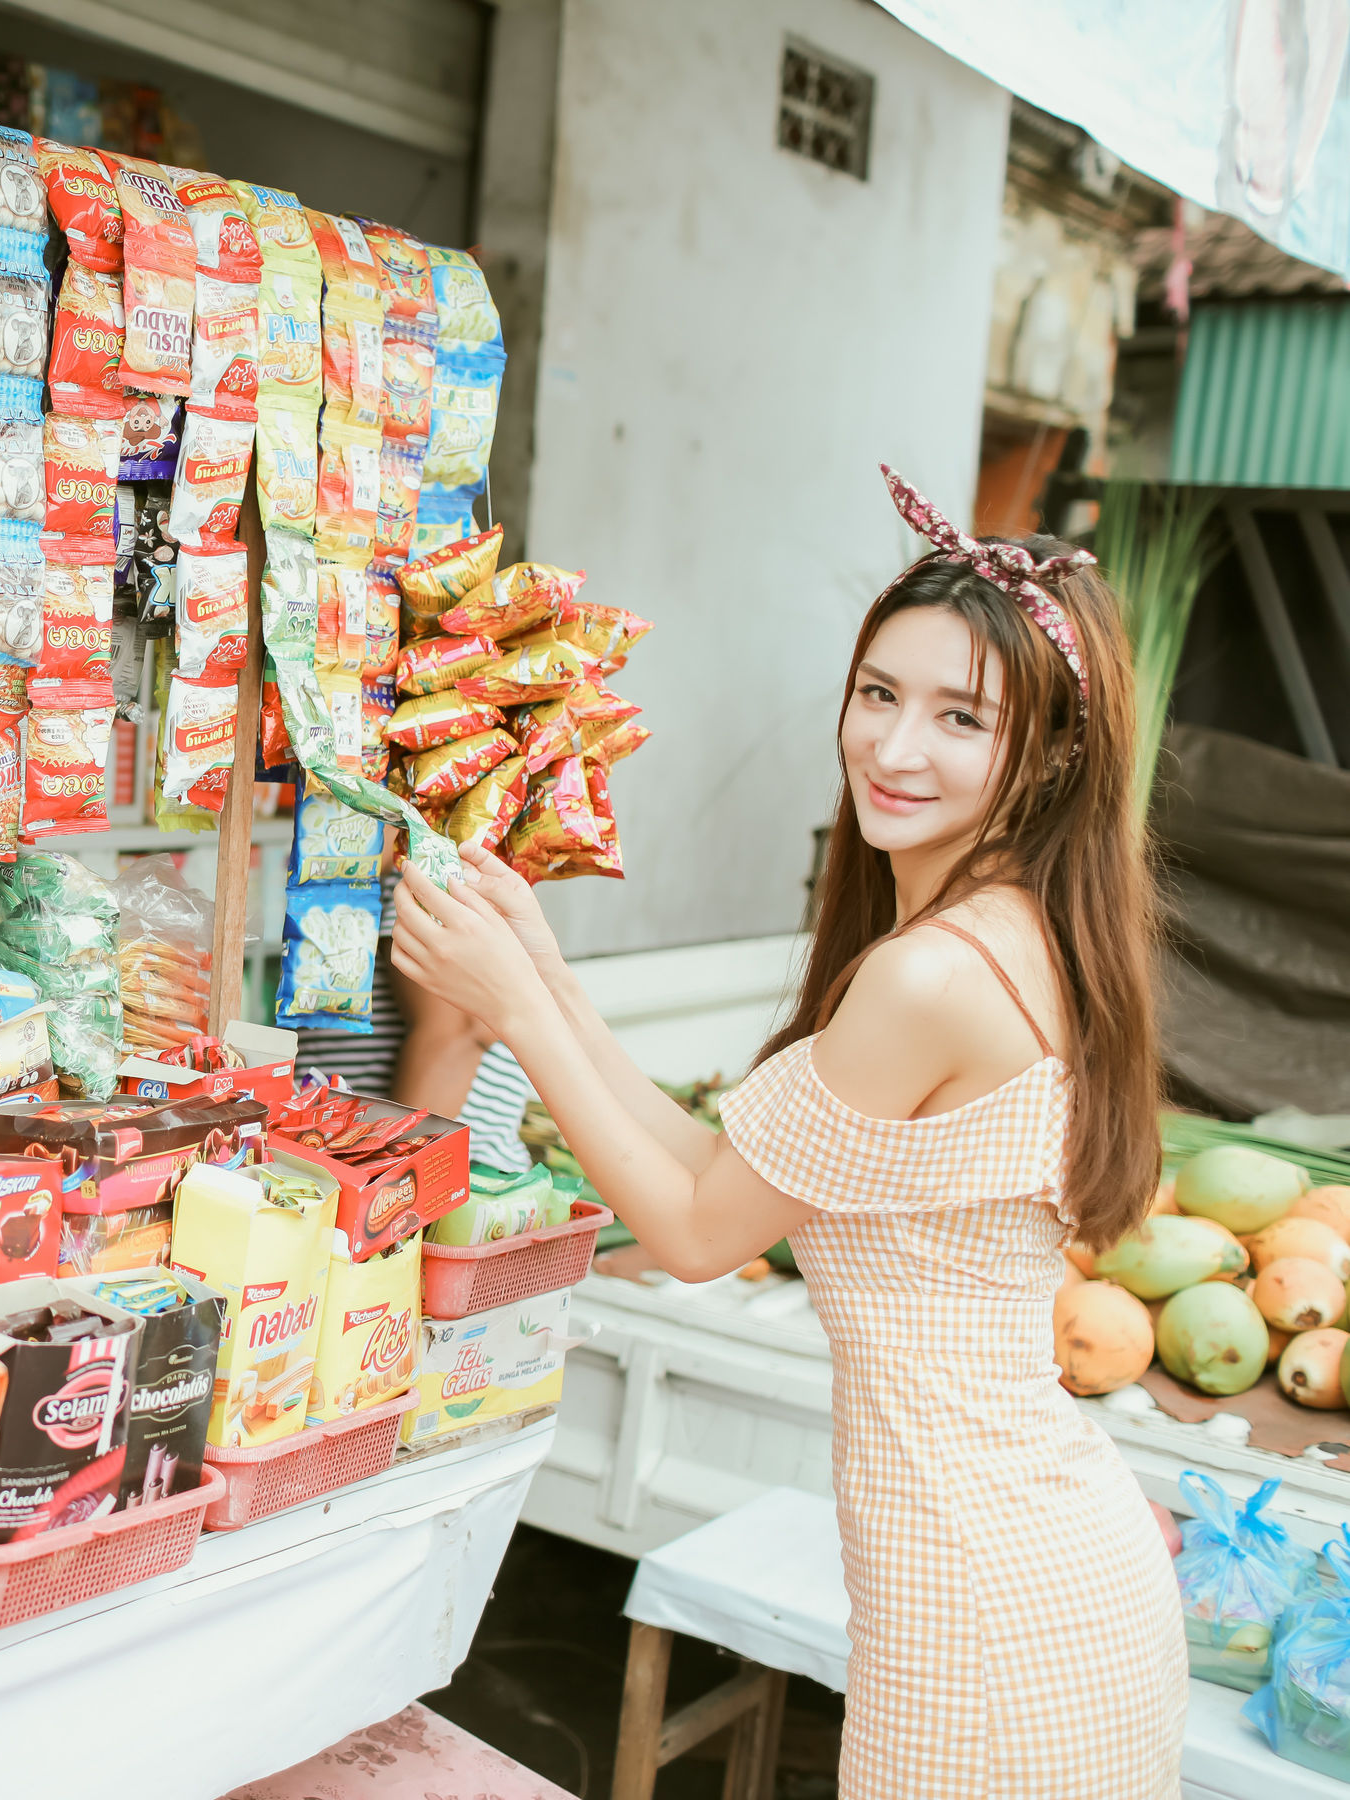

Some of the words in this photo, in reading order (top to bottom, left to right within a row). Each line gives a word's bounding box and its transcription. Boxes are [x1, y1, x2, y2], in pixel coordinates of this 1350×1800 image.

[120, 170, 174, 194] MADU
[249, 184, 303, 210] Pilus
[133, 305, 190, 331] MADU
[266, 313, 320, 344] Pilus
[246, 1287, 282, 1302] Richeese
[249, 1293, 318, 1349] nabati
[349, 1307, 385, 1324] Richeese
[455, 1341, 486, 1371] Teh
[166, 1373, 187, 1384] DARK
[441, 1367, 492, 1400] Gelas
